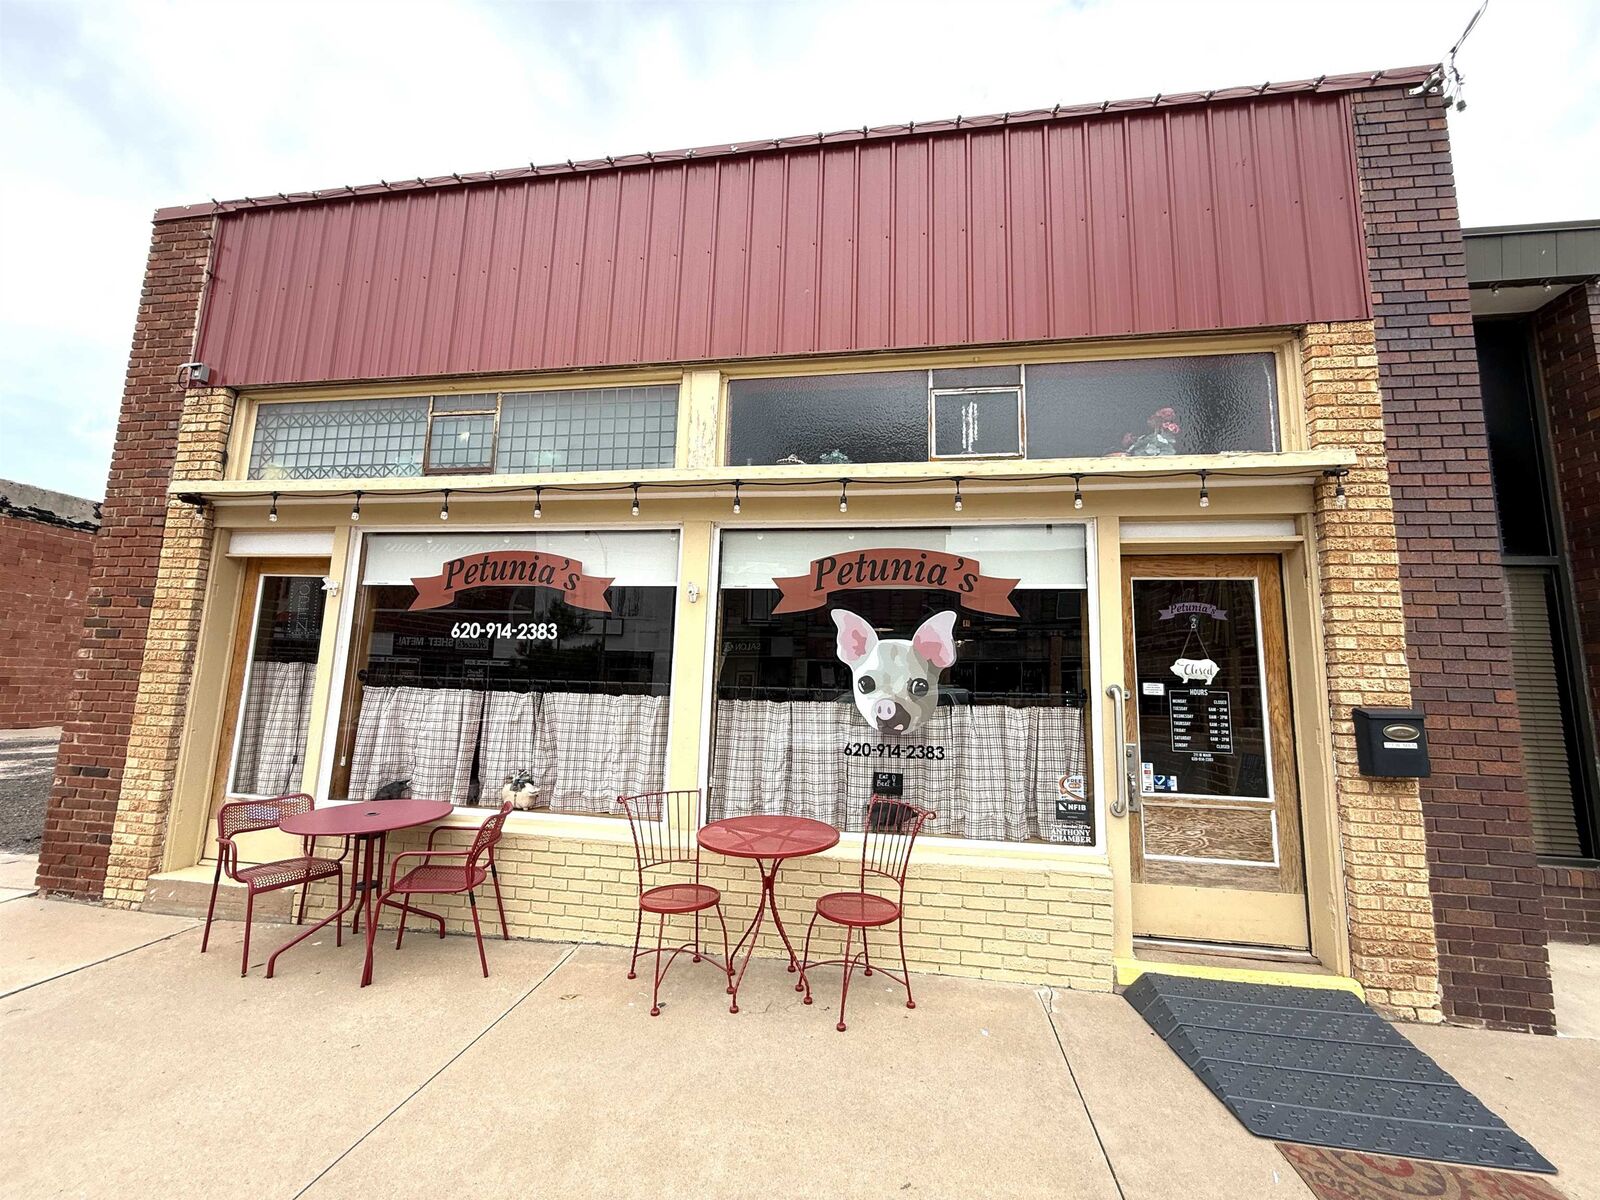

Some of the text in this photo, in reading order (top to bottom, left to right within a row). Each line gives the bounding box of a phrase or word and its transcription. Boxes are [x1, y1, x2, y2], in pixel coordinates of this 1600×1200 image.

[444, 554, 581, 592] Petunia's
[813, 553, 979, 593] Petunia's
[1170, 603, 1217, 615] Petunia's
[450, 621, 559, 641] 620-914-2383
[1183, 664, 1213, 676] Closed
[1189, 688, 1209, 696] HOURS
[843, 742, 946, 761] 620-914-2383
[1067, 803, 1087, 811] NFIB
[1051, 828, 1091, 836] ANTHONY
[1049, 835, 1092, 843] CHAMBER
